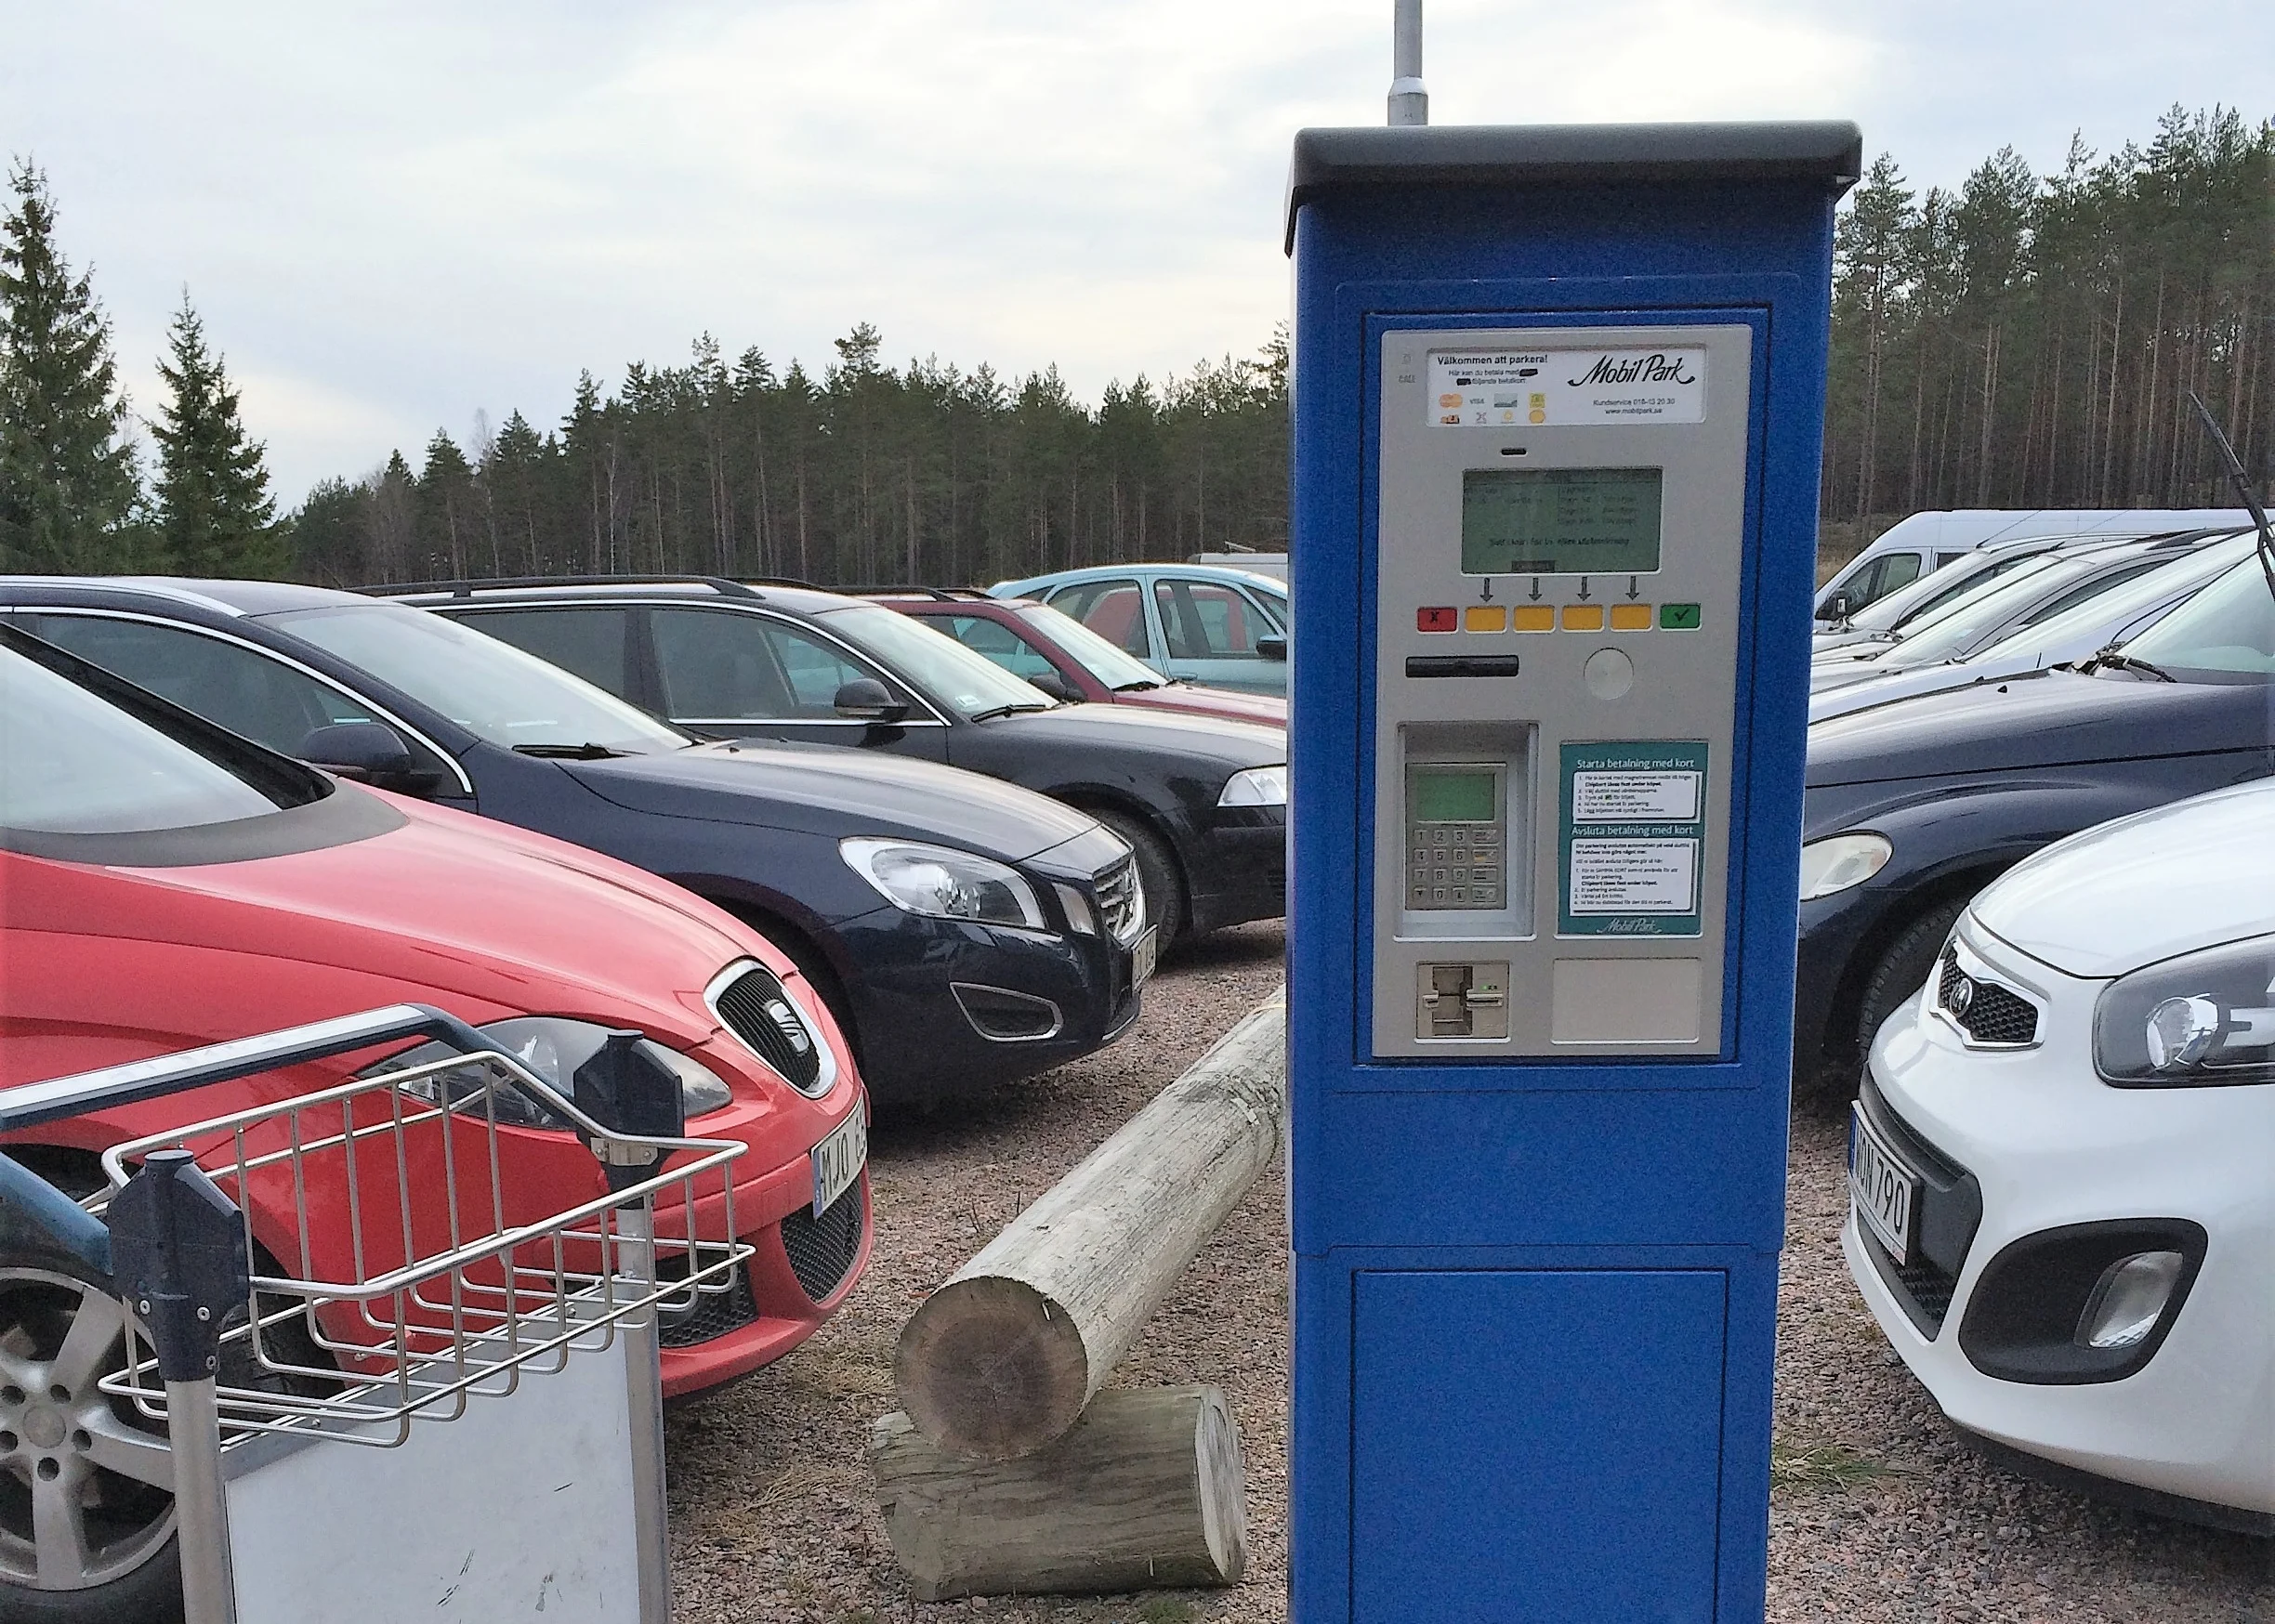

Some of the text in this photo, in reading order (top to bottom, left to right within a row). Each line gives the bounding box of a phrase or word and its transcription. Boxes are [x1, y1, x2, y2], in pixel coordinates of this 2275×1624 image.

[1438, 354, 1548, 365] Välkommen att parkera!
[1567, 353, 1696, 386] Mobil Park
[1577, 757, 1694, 770] Starta betalning med kort
[1437, 831, 1444, 841] 2
[1456, 832, 1464, 842] 3
[1571, 826, 1694, 837] Avsluta betalning med kort
[1437, 851, 1443, 861] 5
[1437, 890, 1443, 900] 0
[822, 1132, 849, 1202] MJO
[1874, 1156, 1905, 1235] 790
